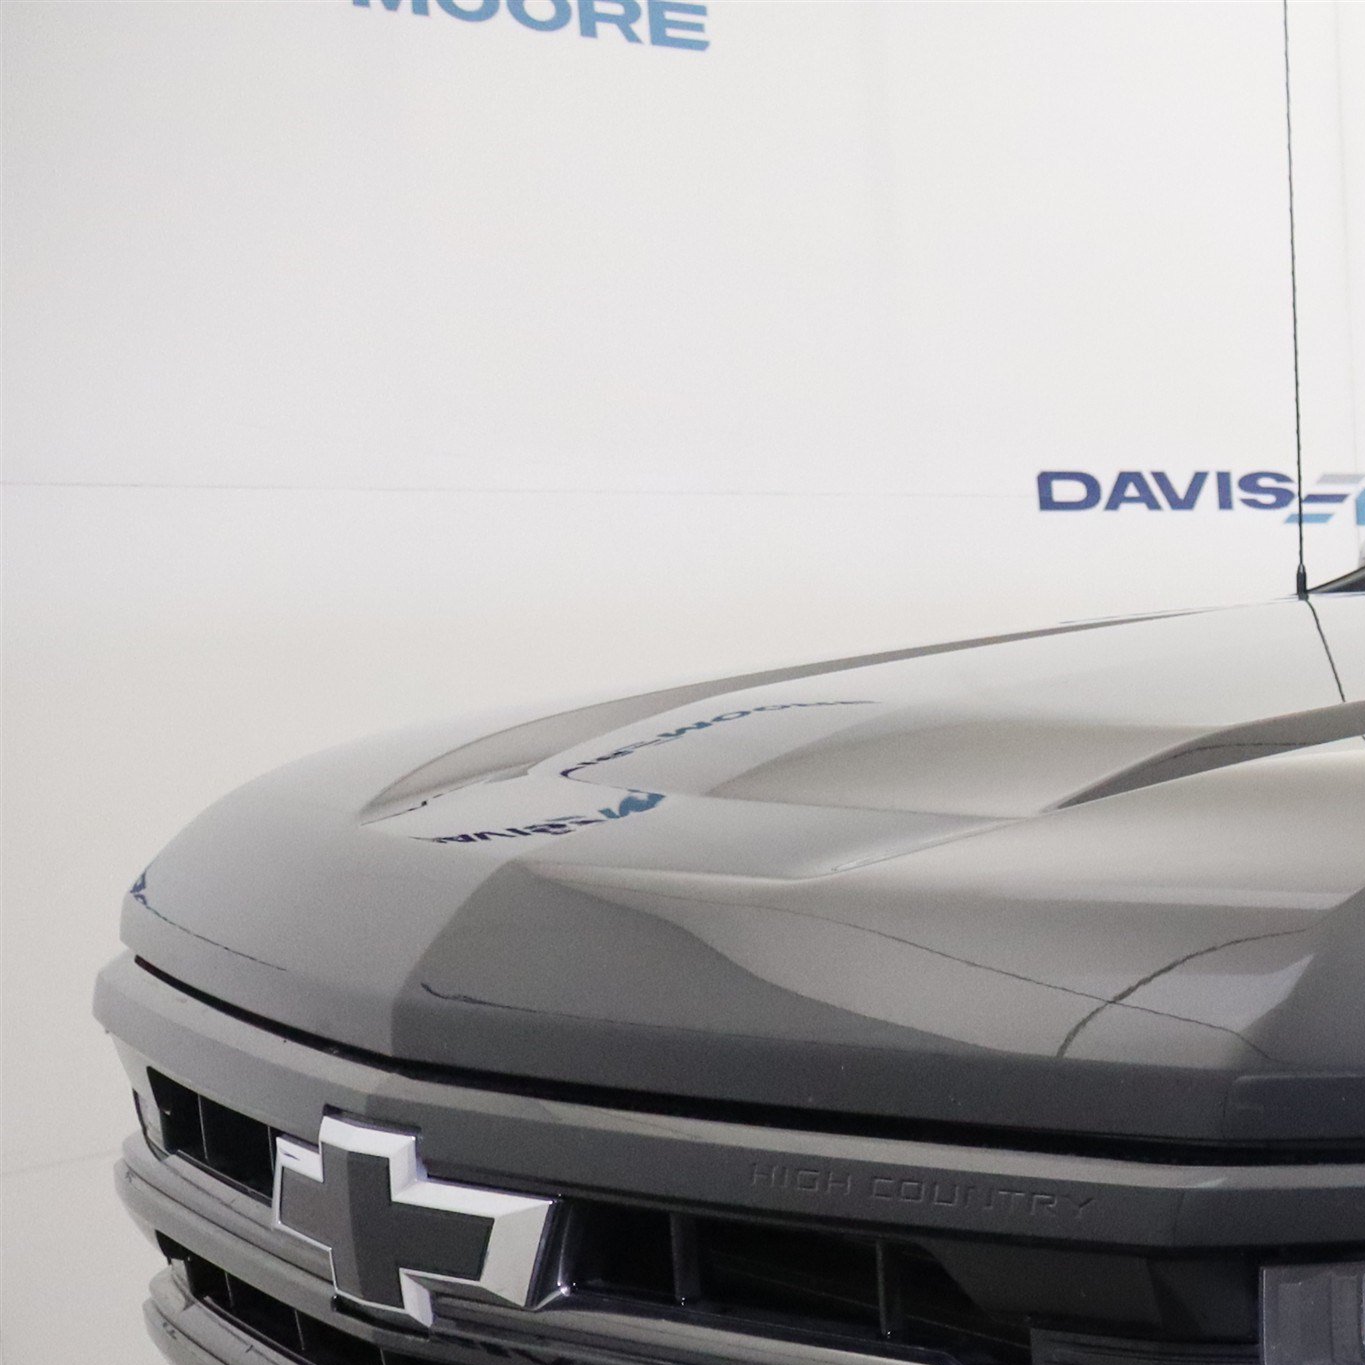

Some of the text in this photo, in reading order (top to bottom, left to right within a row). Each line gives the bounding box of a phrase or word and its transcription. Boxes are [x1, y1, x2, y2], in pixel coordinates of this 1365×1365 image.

[349, 0, 710, 51] ORE
[1037, 471, 1296, 511] DAVIS
[751, 1162, 1095, 1220] HIGH COUNTRY
